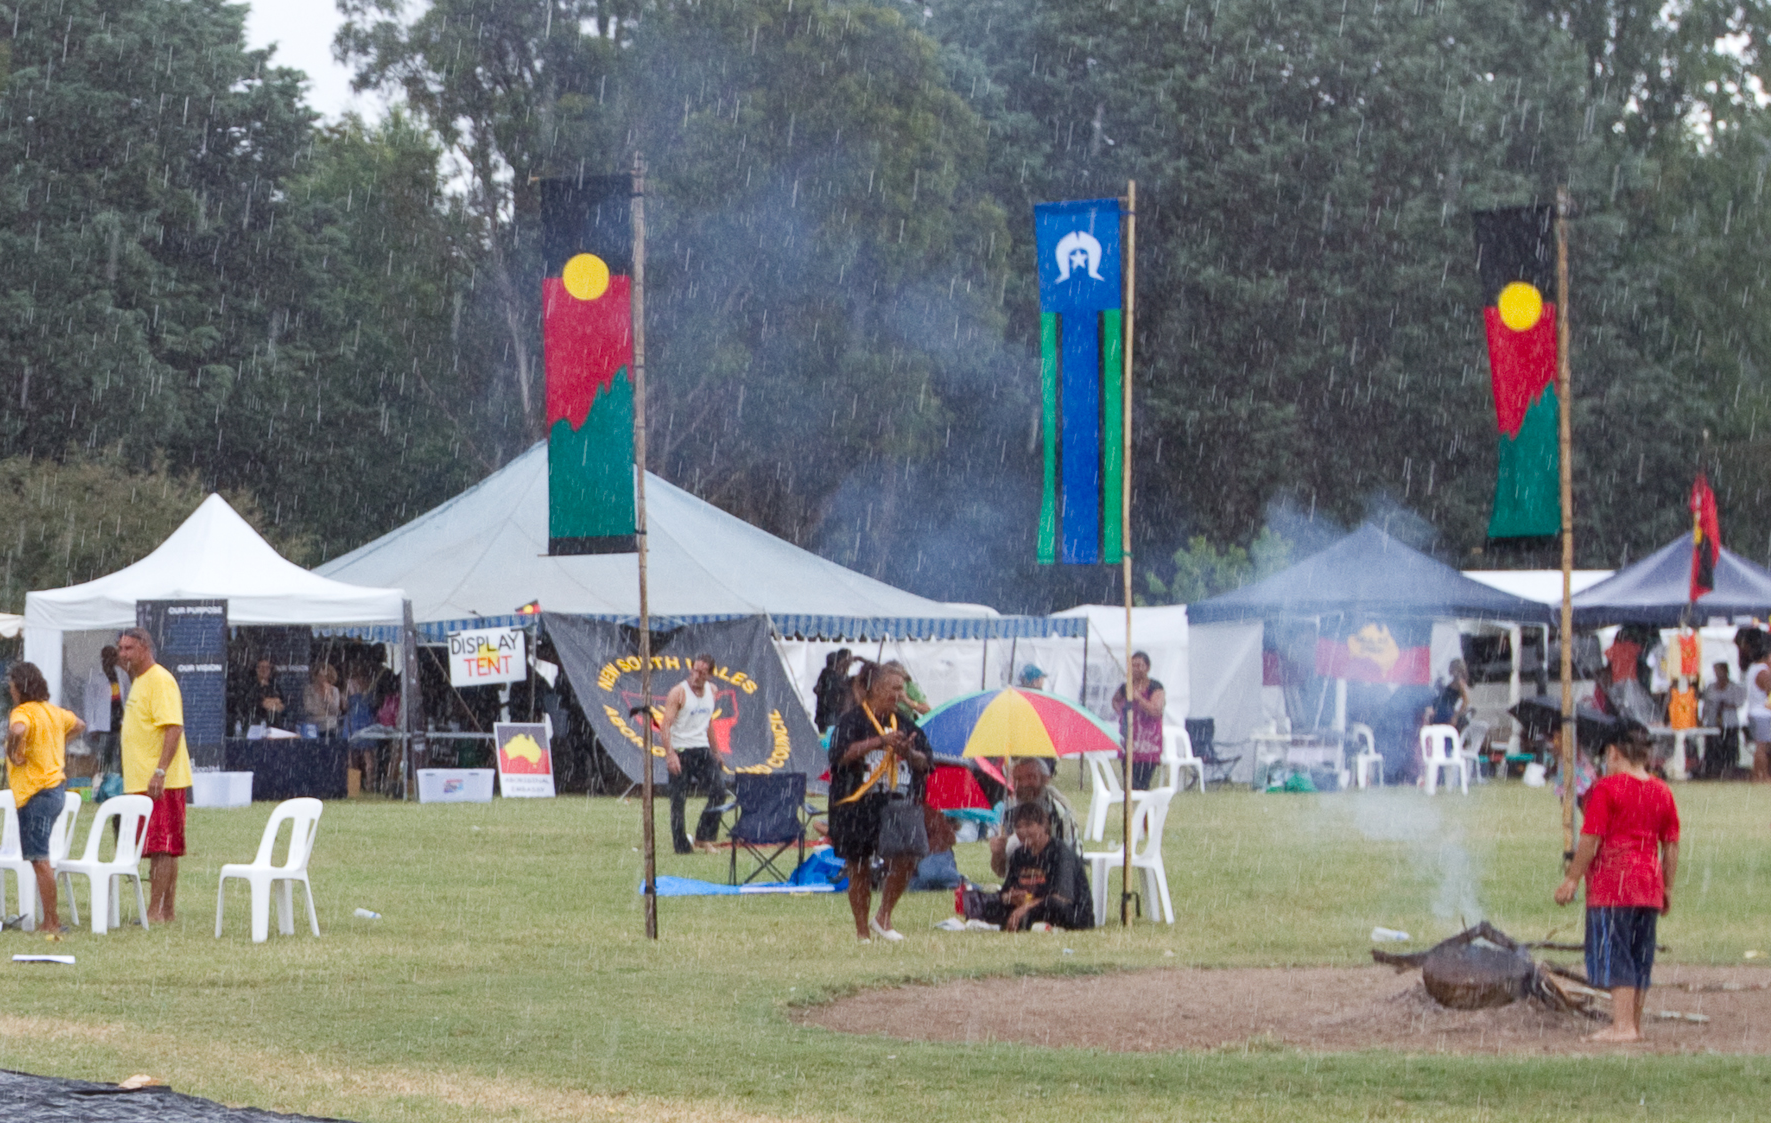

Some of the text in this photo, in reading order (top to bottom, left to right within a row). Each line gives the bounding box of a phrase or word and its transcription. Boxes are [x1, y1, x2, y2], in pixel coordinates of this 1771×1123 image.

[168, 606, 223, 615] OUR PURPOSE
[450, 632, 519, 655] DISPLAY
[177, 664, 222, 672] OUR VISION
[463, 655, 513, 677] TENT
[597, 662, 621, 692] NEW
